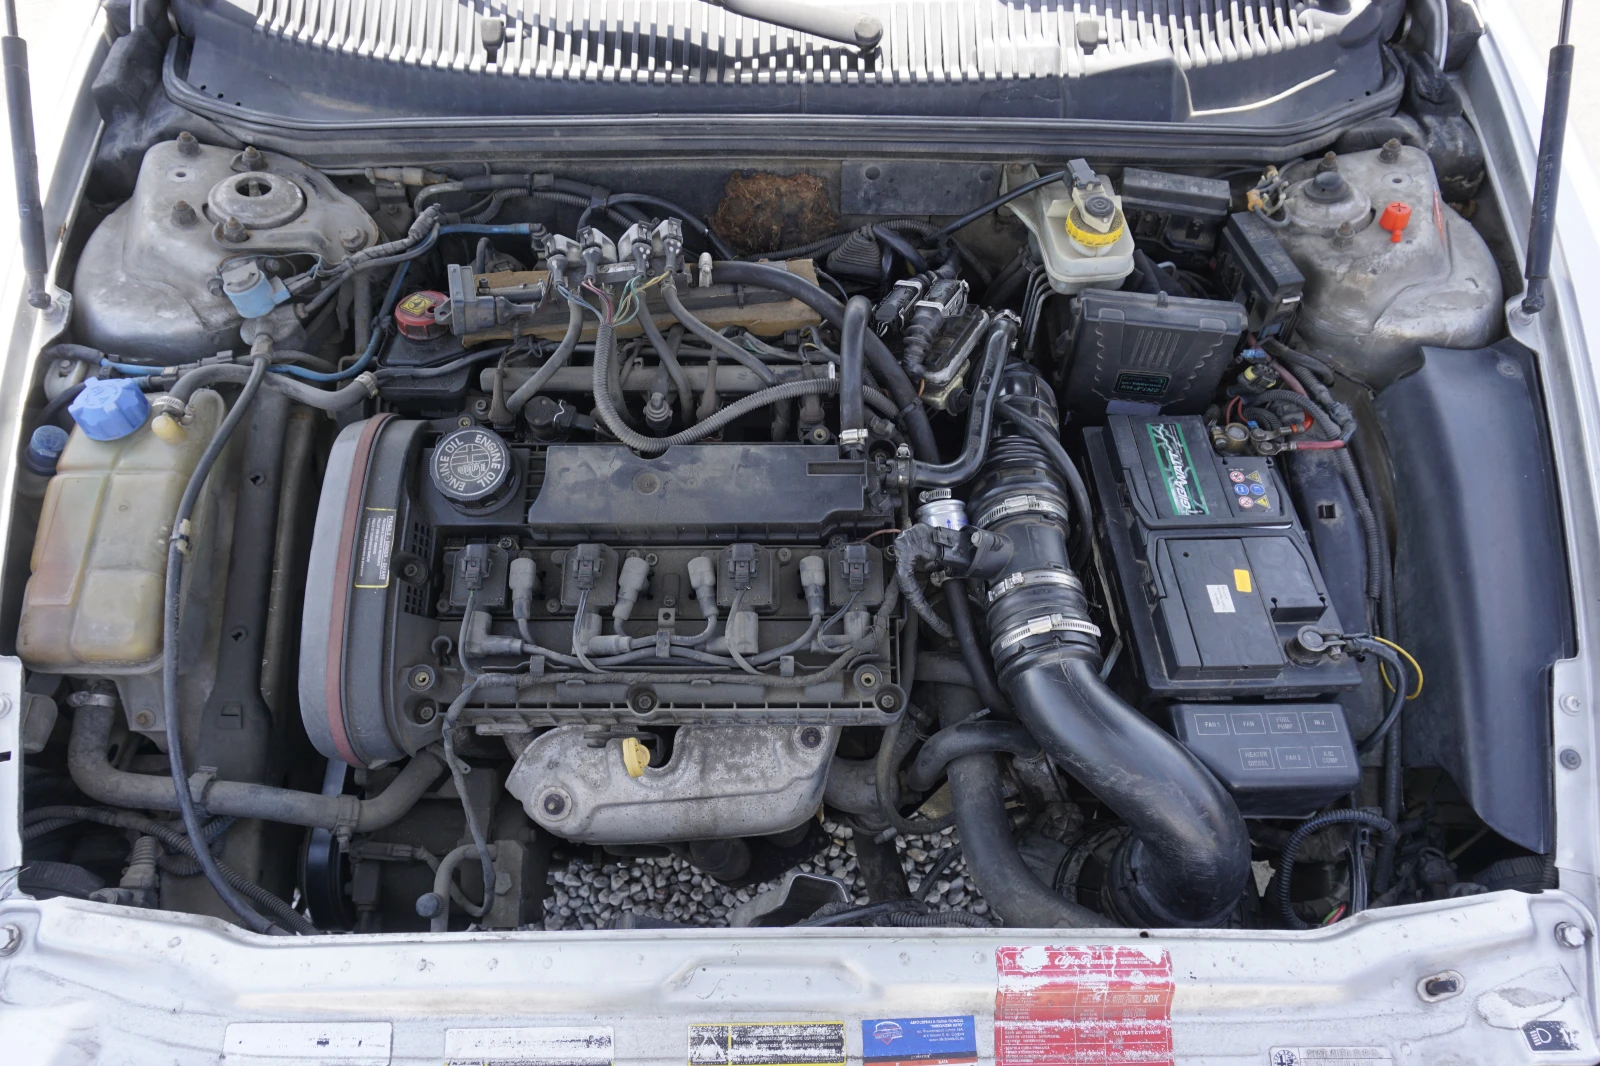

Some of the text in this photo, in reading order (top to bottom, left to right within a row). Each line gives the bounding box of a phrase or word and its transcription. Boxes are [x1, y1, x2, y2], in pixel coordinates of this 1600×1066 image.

[439, 438, 466, 491] ENGINE OIL
[475, 434, 502, 487] ENGINE OIL
[1168, 449, 1192, 510] GIGAWATT
[1054, 954, 1080, 969] Alfa
[1081, 954, 1114, 968] Romeo
[1143, 994, 1160, 1003] 20K
